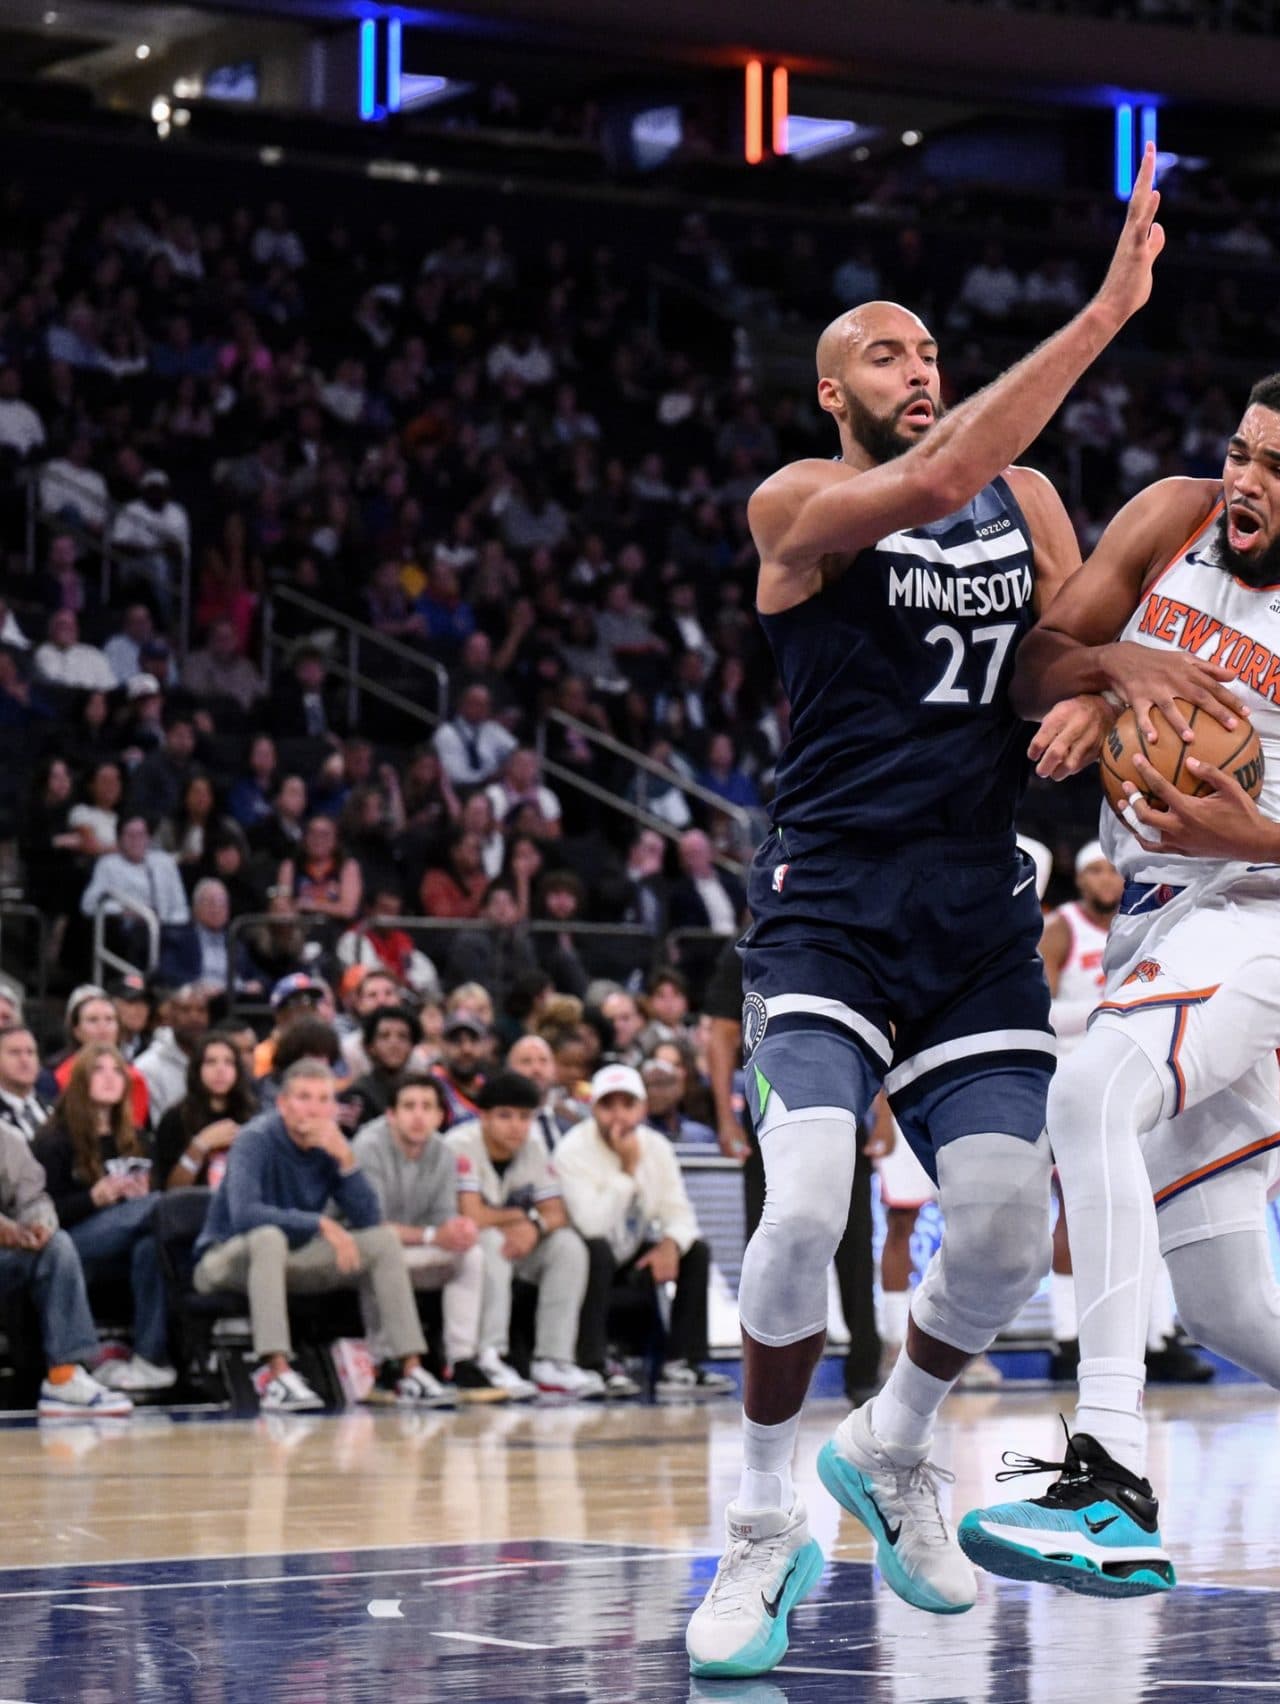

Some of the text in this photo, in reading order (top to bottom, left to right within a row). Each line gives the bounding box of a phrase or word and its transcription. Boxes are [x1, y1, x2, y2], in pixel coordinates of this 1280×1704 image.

[888, 565, 1033, 618] MINNESOTA
[1137, 593, 1221, 654] NEW
[920, 624, 1018, 705] 27
